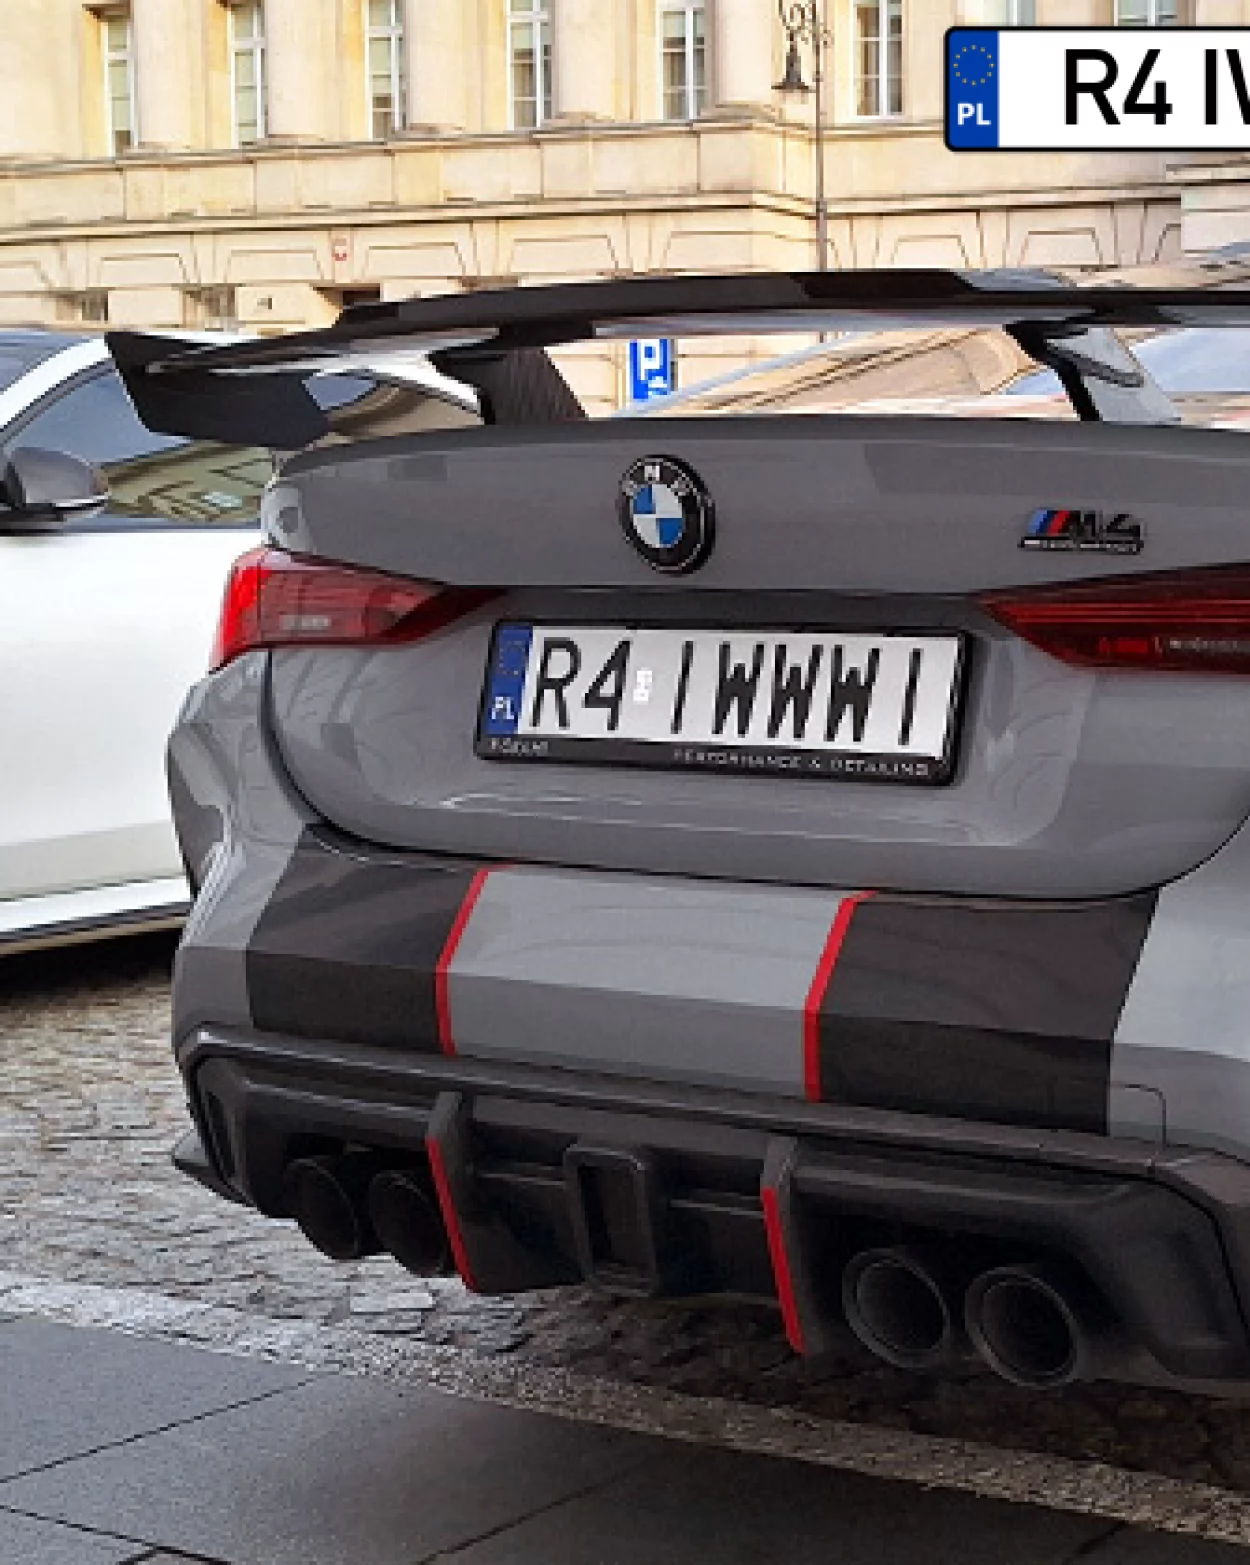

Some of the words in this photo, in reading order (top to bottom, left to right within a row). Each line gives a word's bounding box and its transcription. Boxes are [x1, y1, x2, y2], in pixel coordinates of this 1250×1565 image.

[637, 338, 663, 381] P
[622, 464, 695, 498] BMW
[490, 696, 515, 720] PL
[531, 636, 632, 731] R4
[670, 640, 924, 746] IWWWI
[673, 747, 802, 770] PERFORMANCE
[830, 758, 929, 777] DETAILING
